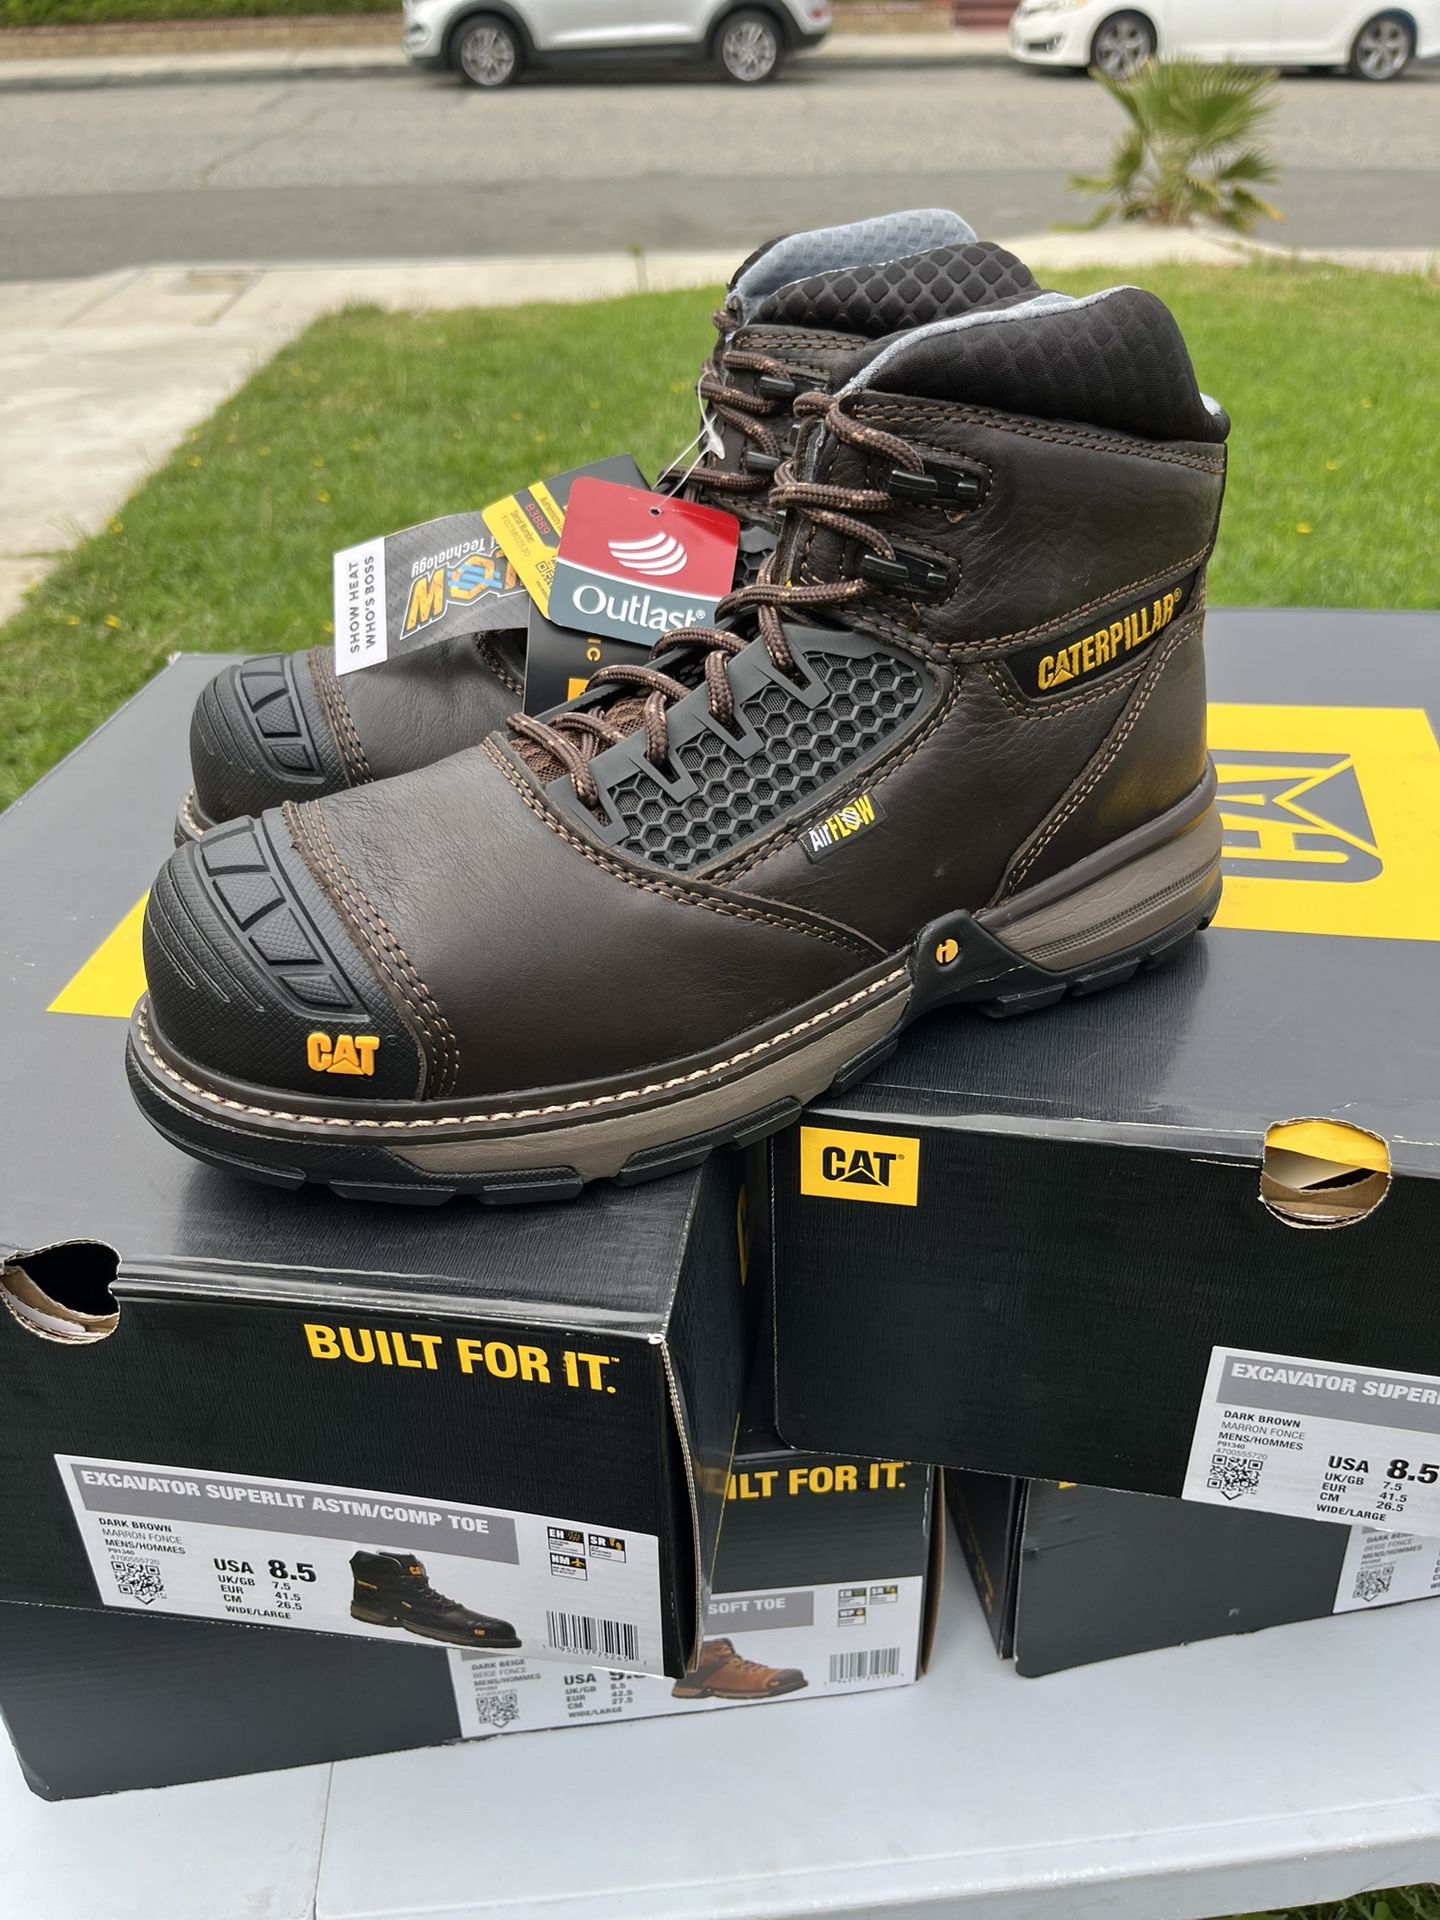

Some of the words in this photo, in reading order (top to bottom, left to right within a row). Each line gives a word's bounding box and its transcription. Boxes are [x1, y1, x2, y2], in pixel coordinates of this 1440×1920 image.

[411, 537, 486, 578] Technology
[348, 561, 359, 601] HEAT
[364, 555, 375, 594] BOSS
[348, 605, 360, 653] SHOW
[364, 597, 376, 648] WHO'S
[808, 794, 875, 852] AirFLOW
[307, 1031, 380, 1076] CAT
[304, 1324, 442, 1370] BUILT
[456, 1338, 550, 1383] FOR
[1231, 1363, 1356, 1393] EXCAVATOR
[1224, 1410, 1255, 1421] DARK
[1258, 1415, 1301, 1428] BROWN
[1221, 1421, 1267, 1435] MARRON
[1270, 1427, 1305, 1440] FONCE
[1218, 1431, 1303, 1450] MENS/HOMMES
[1328, 1455, 1369, 1473] USA
[1386, 1459, 1439, 1484] 8.5
[727, 1471, 778, 1500] ILT
[789, 1465, 858, 1495] FOR
[1324, 1472, 1364, 1486] UK/GB
[1382, 1481, 1402, 1491] 7.5
[81, 1470, 201, 1496] EXCAVATOR
[205, 1483, 305, 1509] SUPERLIT
[312, 1496, 442, 1526] ASTM/COMP
[448, 1514, 489, 1534] TOE
[1320, 1492, 1340, 1502] CM
[1376, 1500, 1404, 1512] 26.5
[1322, 1482, 1347, 1493] EUR
[1379, 1492, 1407, 1503] 41.5
[1316, 1503, 1387, 1522] WIDE/LARGE
[99, 1517, 129, 1528] DARK
[131, 1520, 172, 1532] BROWN
[549, 1528, 565, 1539] EH
[102, 1529, 146, 1540] MARRON
[148, 1534, 182, 1544] FONCE
[590, 1536, 607, 1546] SR
[105, 1539, 186, 1555] MENS/HOMMES
[213, 1558, 254, 1574] USA
[268, 1559, 317, 1582] 8.5
[217, 1574, 255, 1586] UK/GB
[272, 1581, 291, 1590] 7.5
[220, 1584, 244, 1594] EUR
[275, 1591, 301, 1601] 41.5
[223, 1594, 242, 1603] CM
[276, 1600, 302, 1610] 26.5
[225, 1605, 292, 1619] WIDE/LARGE
[708, 1600, 750, 1615] SOFT
[753, 1598, 786, 1611] TOE
[472, 1662, 497, 1671] DARK
[499, 1659, 526, 1668] BEIGE
[473, 1673, 542, 1686] MENS/HOMMES
[564, 1673, 597, 1686] USA
[565, 1686, 597, 1695] UK/GB
[566, 1694, 586, 1702] EUR
[567, 1701, 584, 1710] CM
[568, 1706, 623, 1718] WIDE/LARGE
